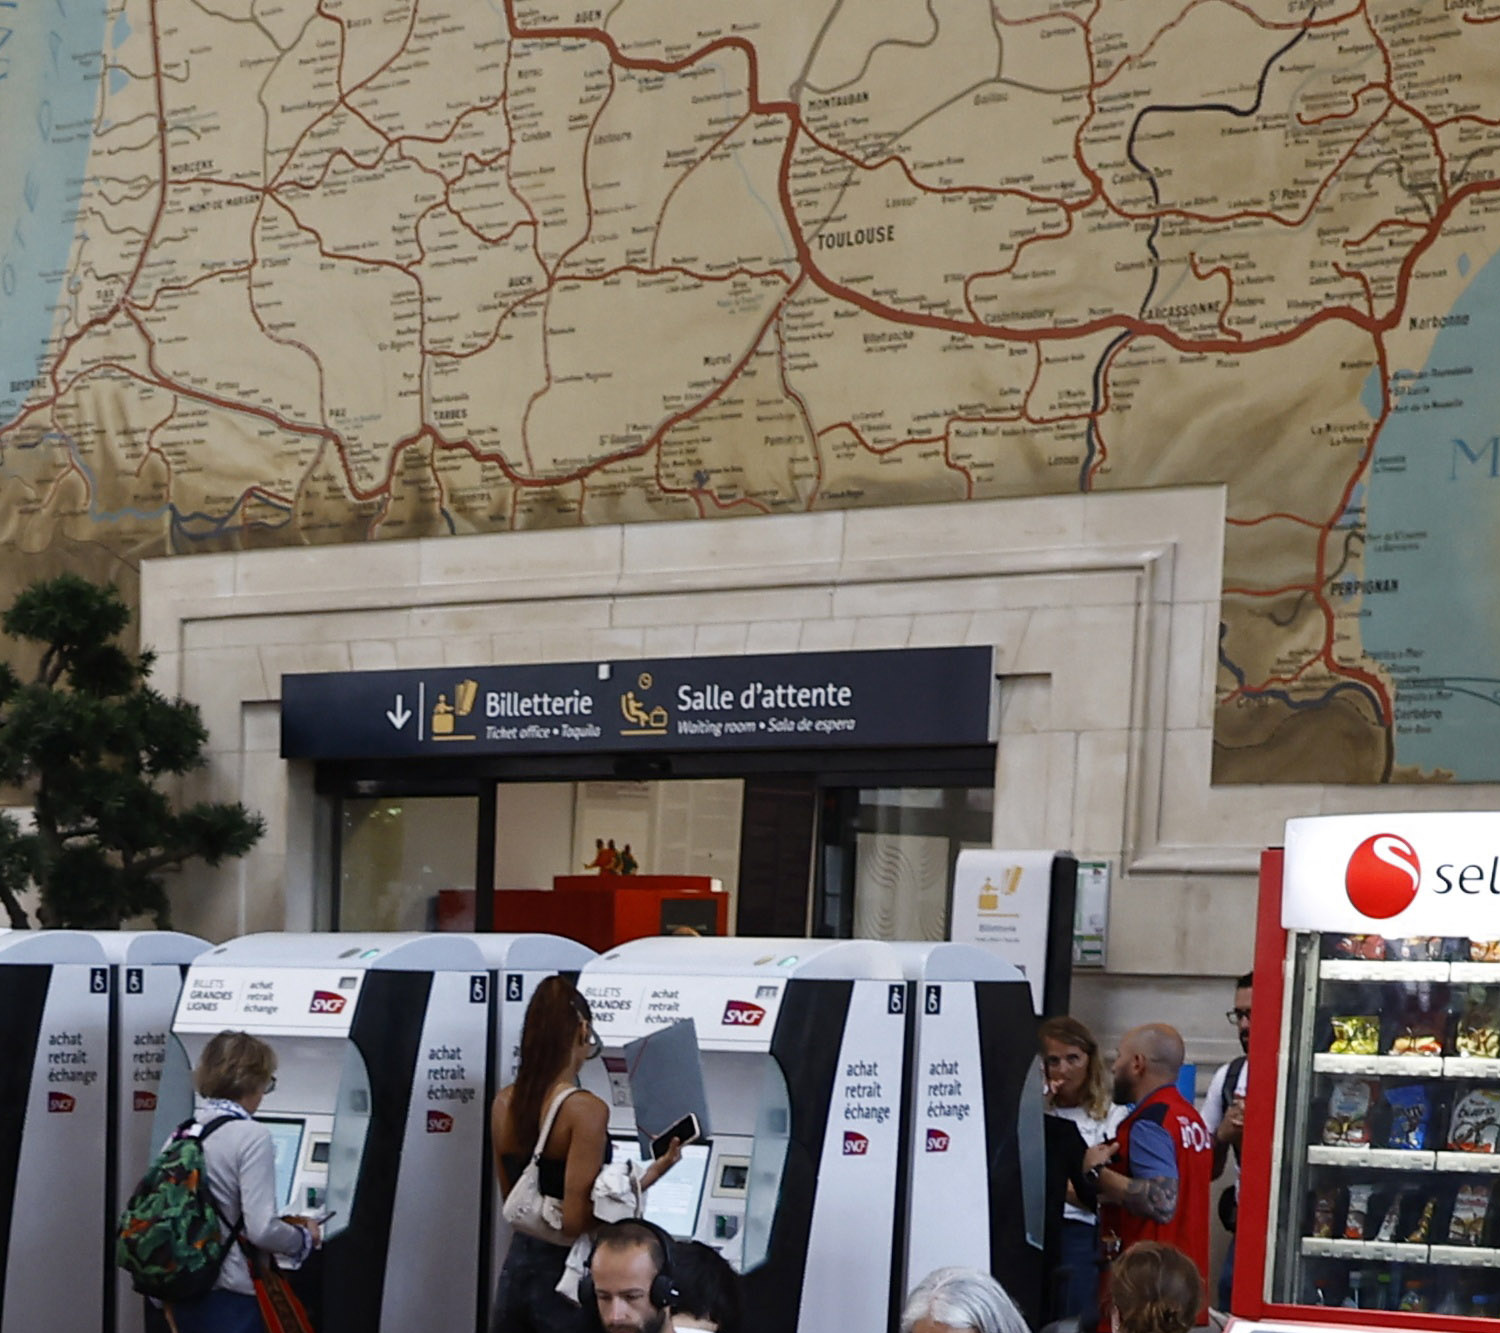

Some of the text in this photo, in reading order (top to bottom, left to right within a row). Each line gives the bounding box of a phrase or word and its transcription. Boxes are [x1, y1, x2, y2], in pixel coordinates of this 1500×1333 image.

[574, 9, 603, 24] AGEN
[808, 91, 871, 111] MONTAUBAN
[817, 225, 897, 251] TOULOUSE
[1409, 313, 1471, 332] Narbonne
[433, 407, 468, 421] TARBES
[1330, 577, 1400, 598] PERPIGNAN
[485, 682, 854, 719] Billetterie Salle d'attente
[485, 724, 518, 740] Ticket
[519, 723, 552, 740] office
[677, 719, 724, 738] Waiting
[724, 721, 757, 735] room
[767, 719, 797, 735] Sala
[796, 718, 814, 734] de
[813, 719, 857, 736] espera
[192, 978, 275, 991] BILLETS achat
[189, 990, 275, 1002] GRANDES retrait
[650, 988, 680, 1000] achat
[186, 998, 346, 1016] LIGNES échange SNCF
[588, 999, 681, 1013] RANDES retrait
[723, 1008, 765, 1025] SNCF
[48, 1031, 83, 1046] achat
[133, 1031, 166, 1046] achat
[47, 1050, 87, 1065] retrait
[133, 1050, 165, 1064] retrai
[428, 1044, 463, 1061] achat
[427, 1064, 466, 1081] retrait
[845, 1060, 880, 1078] achat
[929, 1058, 960, 1076] achat
[47, 1068, 98, 1086] échange
[426, 1084, 476, 1105] échange
[844, 1081, 882, 1099] retrait
[927, 1079, 963, 1098] retrait
[843, 1103, 892, 1124] échange
[926, 1101, 971, 1121] échange
[843, 1138, 870, 1154] SNCF
[925, 1136, 950, 1151] SNCF
